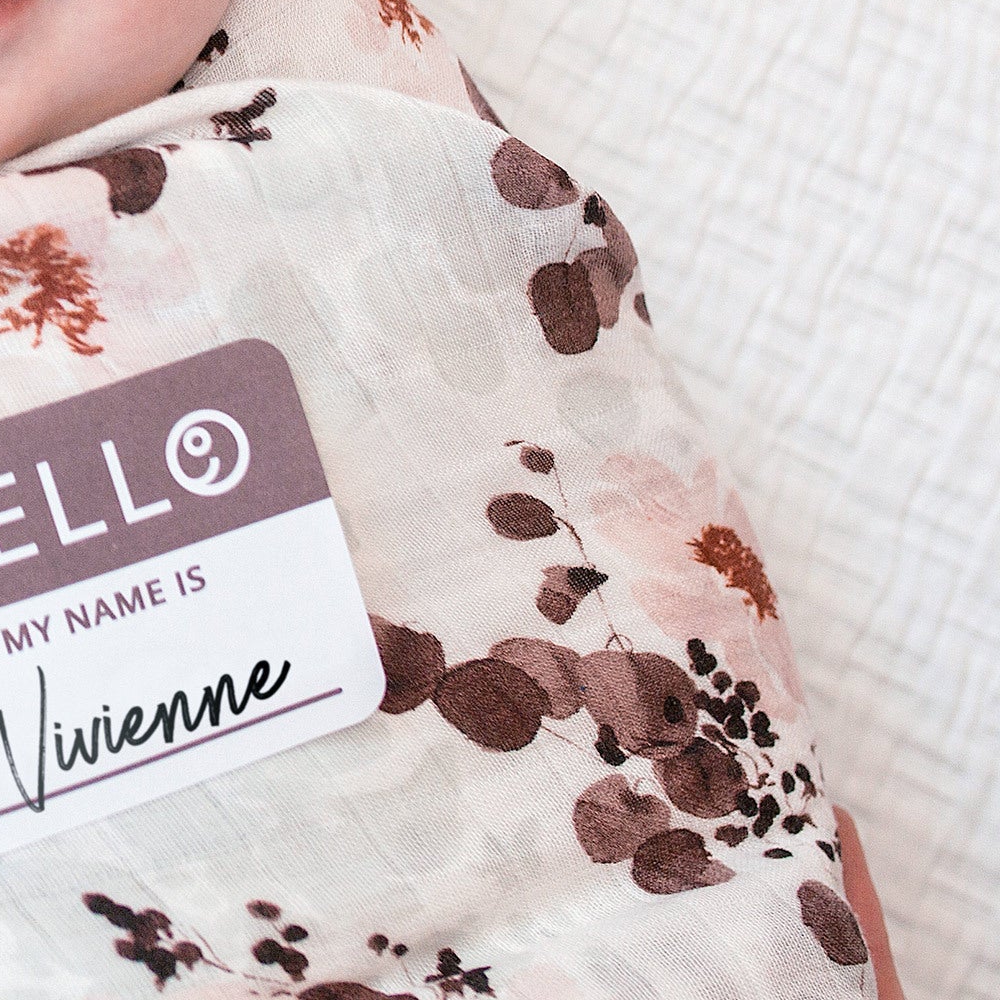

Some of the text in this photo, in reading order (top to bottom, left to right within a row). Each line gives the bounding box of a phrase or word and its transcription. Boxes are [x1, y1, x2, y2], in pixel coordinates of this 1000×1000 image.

[0, 564, 207, 655] MY NAME IS
